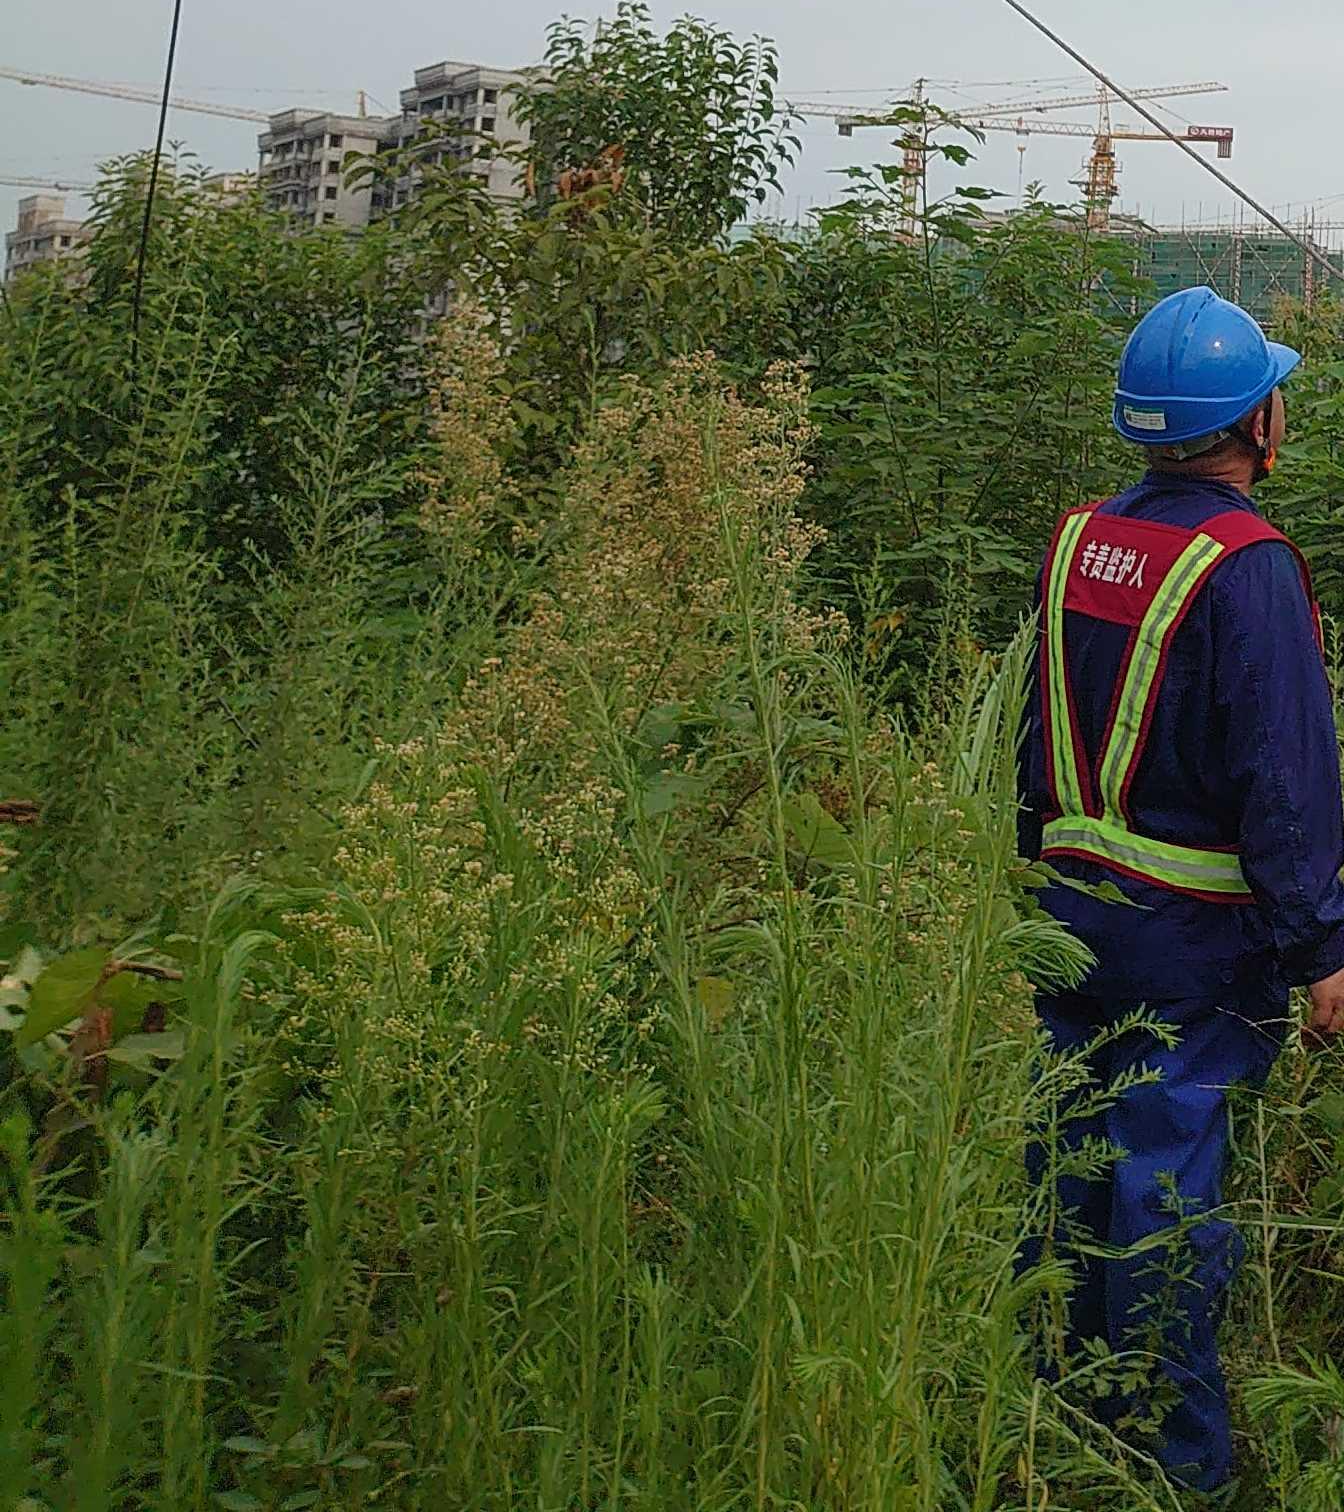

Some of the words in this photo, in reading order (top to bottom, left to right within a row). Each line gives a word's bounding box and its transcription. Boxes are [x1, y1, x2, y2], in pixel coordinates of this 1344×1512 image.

[1080, 540, 1148, 589] 专责监护人
